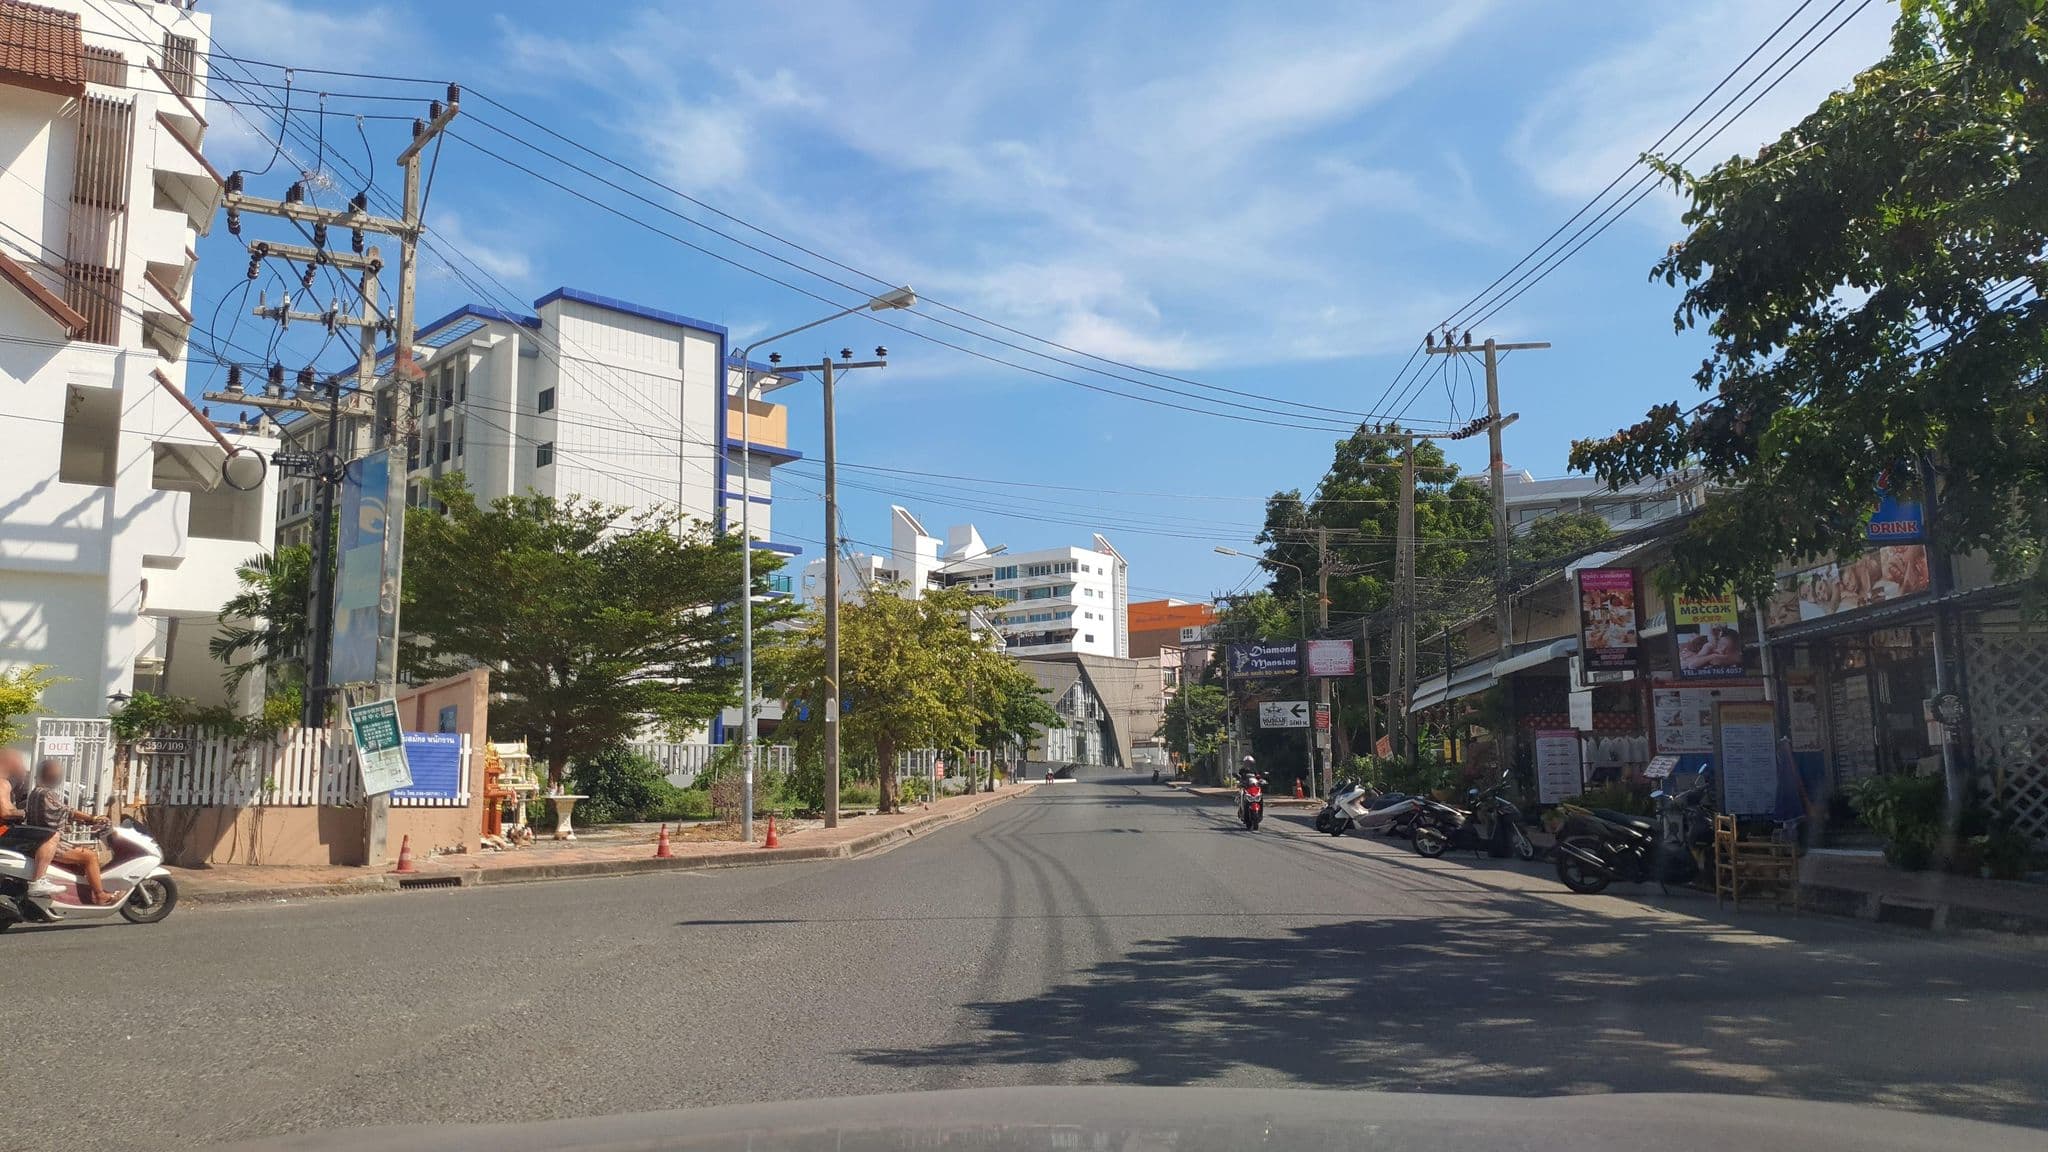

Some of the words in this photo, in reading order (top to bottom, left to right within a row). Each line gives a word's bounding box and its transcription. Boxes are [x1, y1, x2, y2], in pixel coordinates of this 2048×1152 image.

[1870, 521, 1918, 535] DRINK
[1249, 643, 1297, 657] Diamond
[1250, 657, 1297, 669] Mansion
[48, 742, 71, 751] OUT
